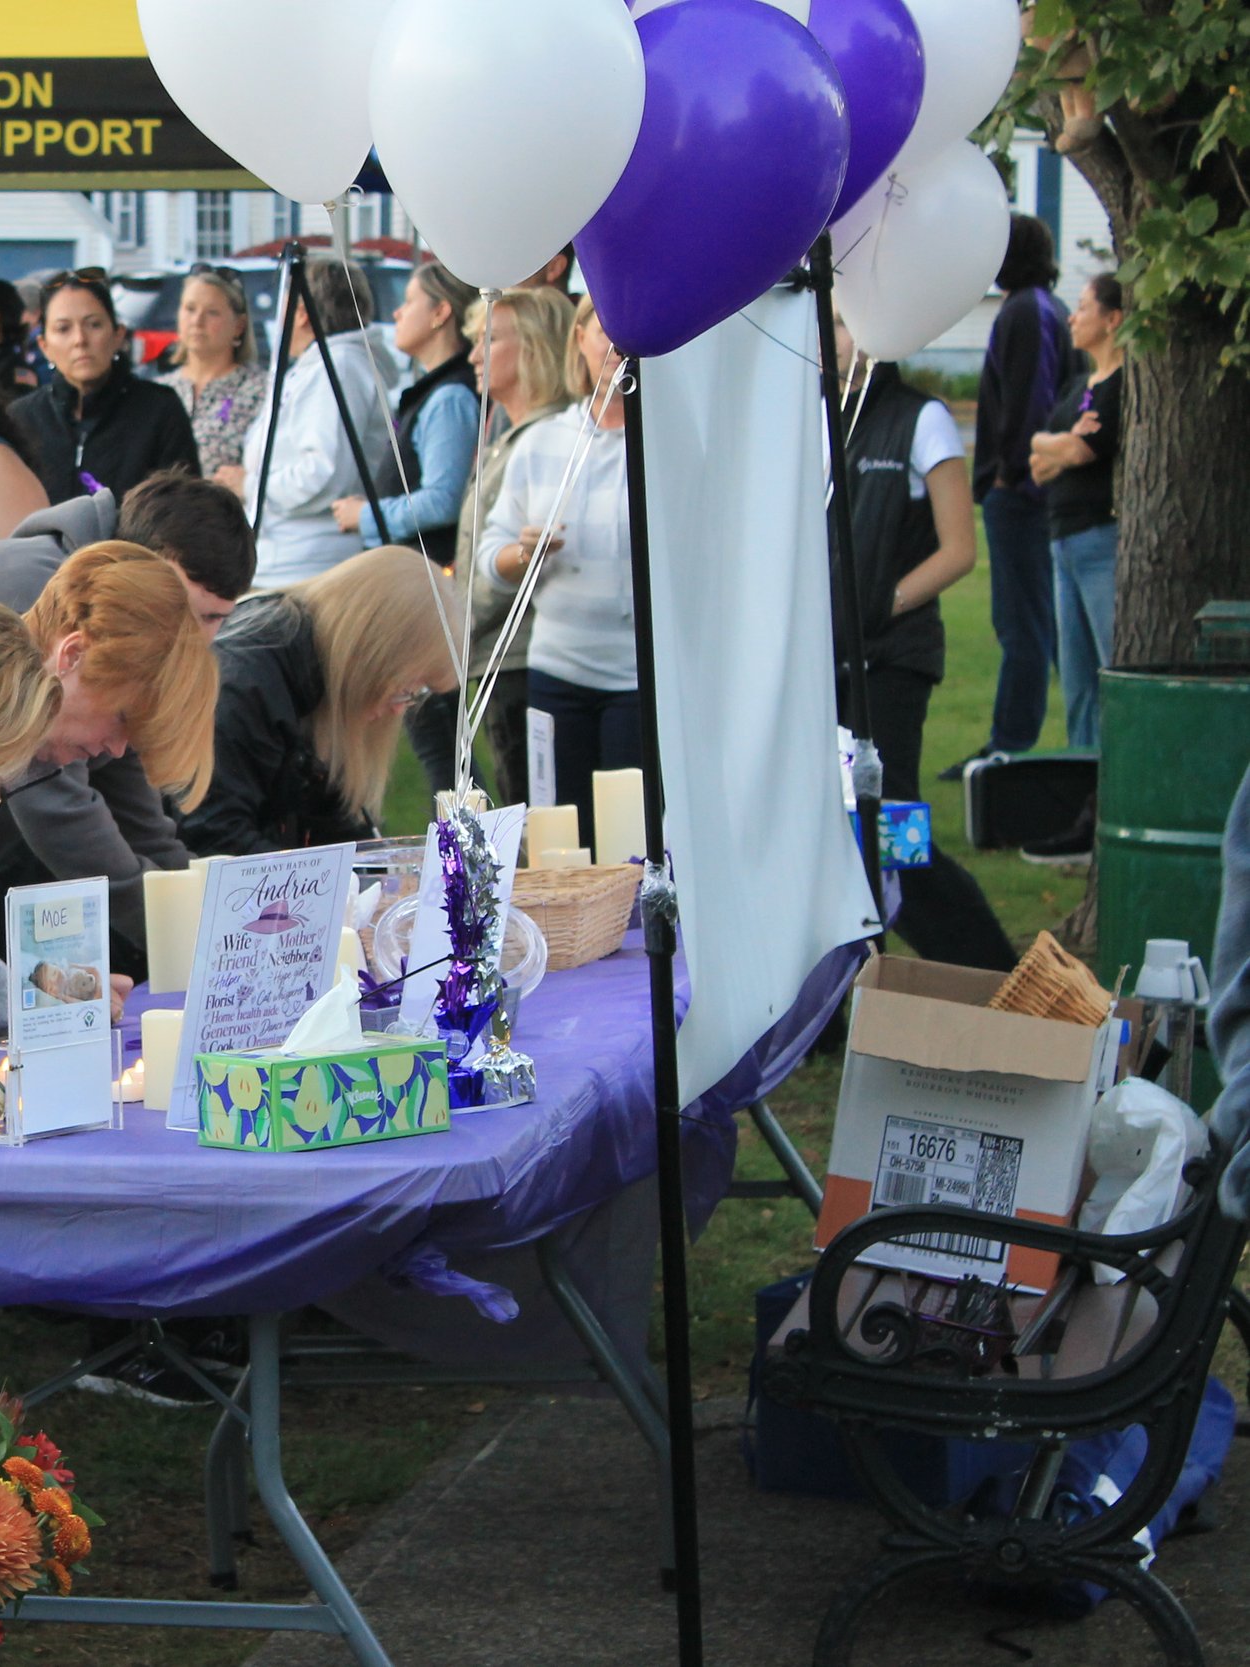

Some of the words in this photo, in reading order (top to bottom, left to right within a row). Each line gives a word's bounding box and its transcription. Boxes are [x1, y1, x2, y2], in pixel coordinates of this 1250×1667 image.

[241, 866, 258, 877] THE
[261, 863, 283, 874] MANY
[286, 860, 307, 871] HATS
[311, 858, 323, 867] OF
[224, 870, 332, 912] Andria
[42, 908, 68, 929] MOE
[223, 931, 253, 952] Wife
[277, 930, 317, 949] Mother
[217, 950, 259, 972] Friend
[267, 948, 311, 969] Neighbor
[213, 972, 242, 991] Helper
[205, 993, 236, 1010] Florist
[256, 989, 272, 1006] Cat
[211, 1010, 234, 1024] Home
[236, 1006, 262, 1021] health
[200, 1023, 251, 1041] Generous
[208, 1038, 235, 1053] Cook
[909, 1132, 957, 1163] 16676
